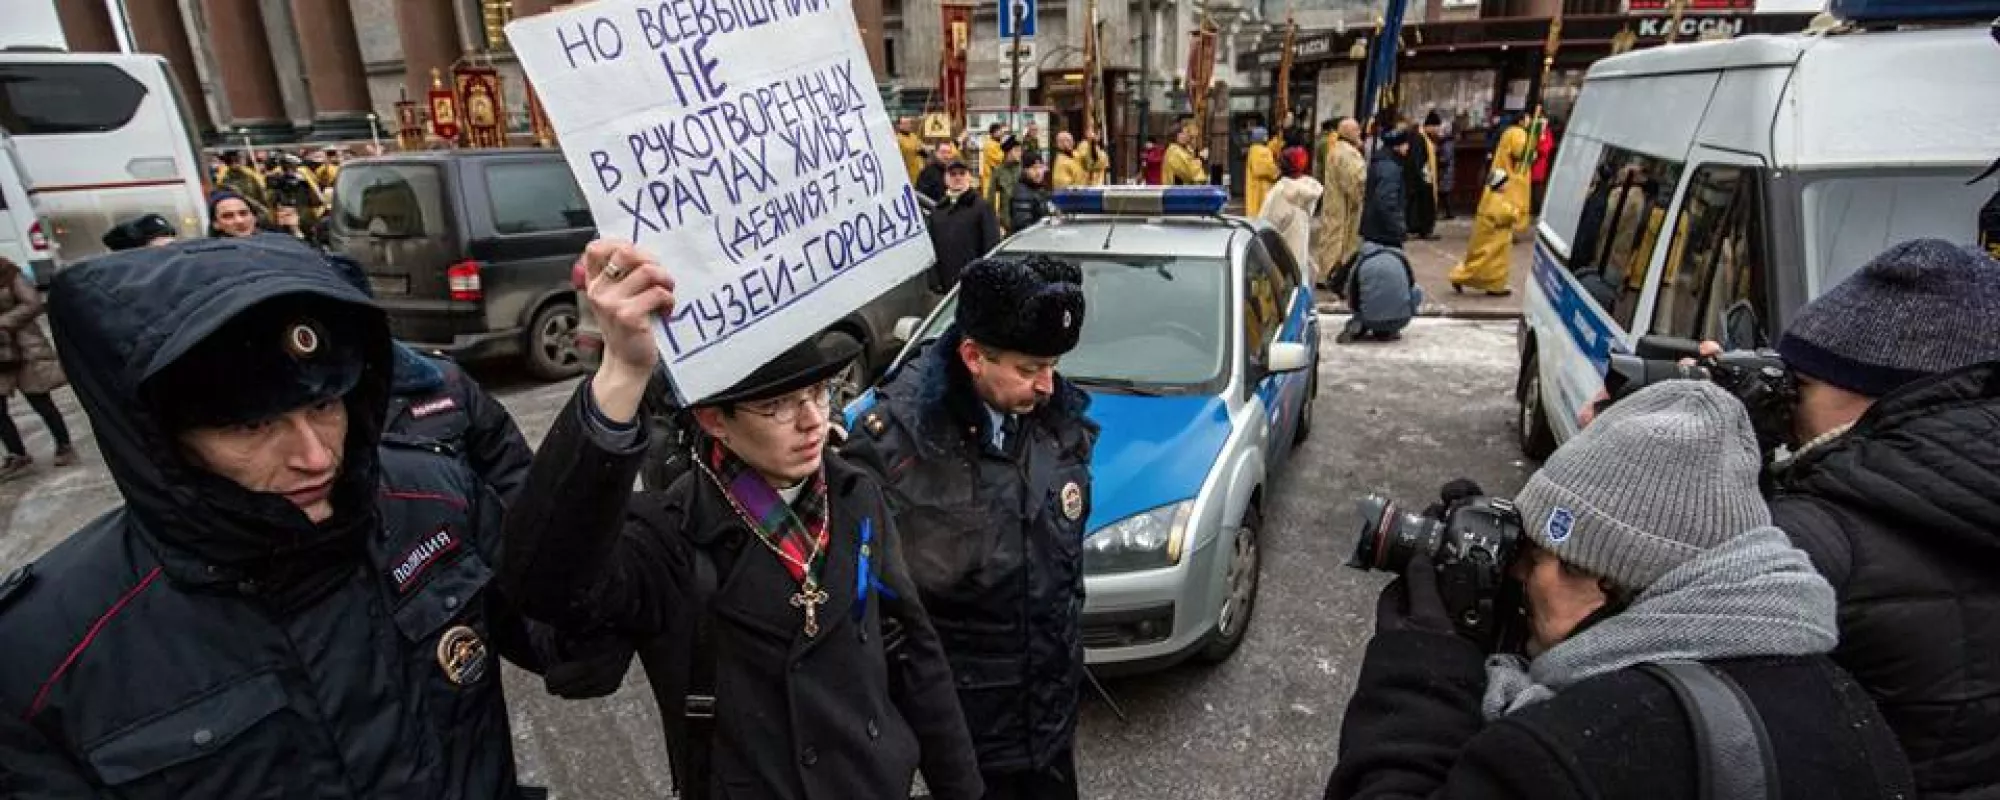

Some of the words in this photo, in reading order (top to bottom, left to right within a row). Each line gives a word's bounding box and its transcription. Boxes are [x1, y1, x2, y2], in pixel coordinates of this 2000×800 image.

[556, 16, 623, 68] НО
[636, 0, 829, 50] ВСЕВЫШ
[660, 36, 728, 107] НЕ
[590, 150, 622, 193] В
[628, 58, 864, 178] РУКОТВОРЕННЫХ
[617, 137, 778, 245] ХРАМАХ
[777, 103, 875, 177] ЖИВЕТ
[661, 183, 923, 355] МУЗЕЙ-ГОРОДУ!
